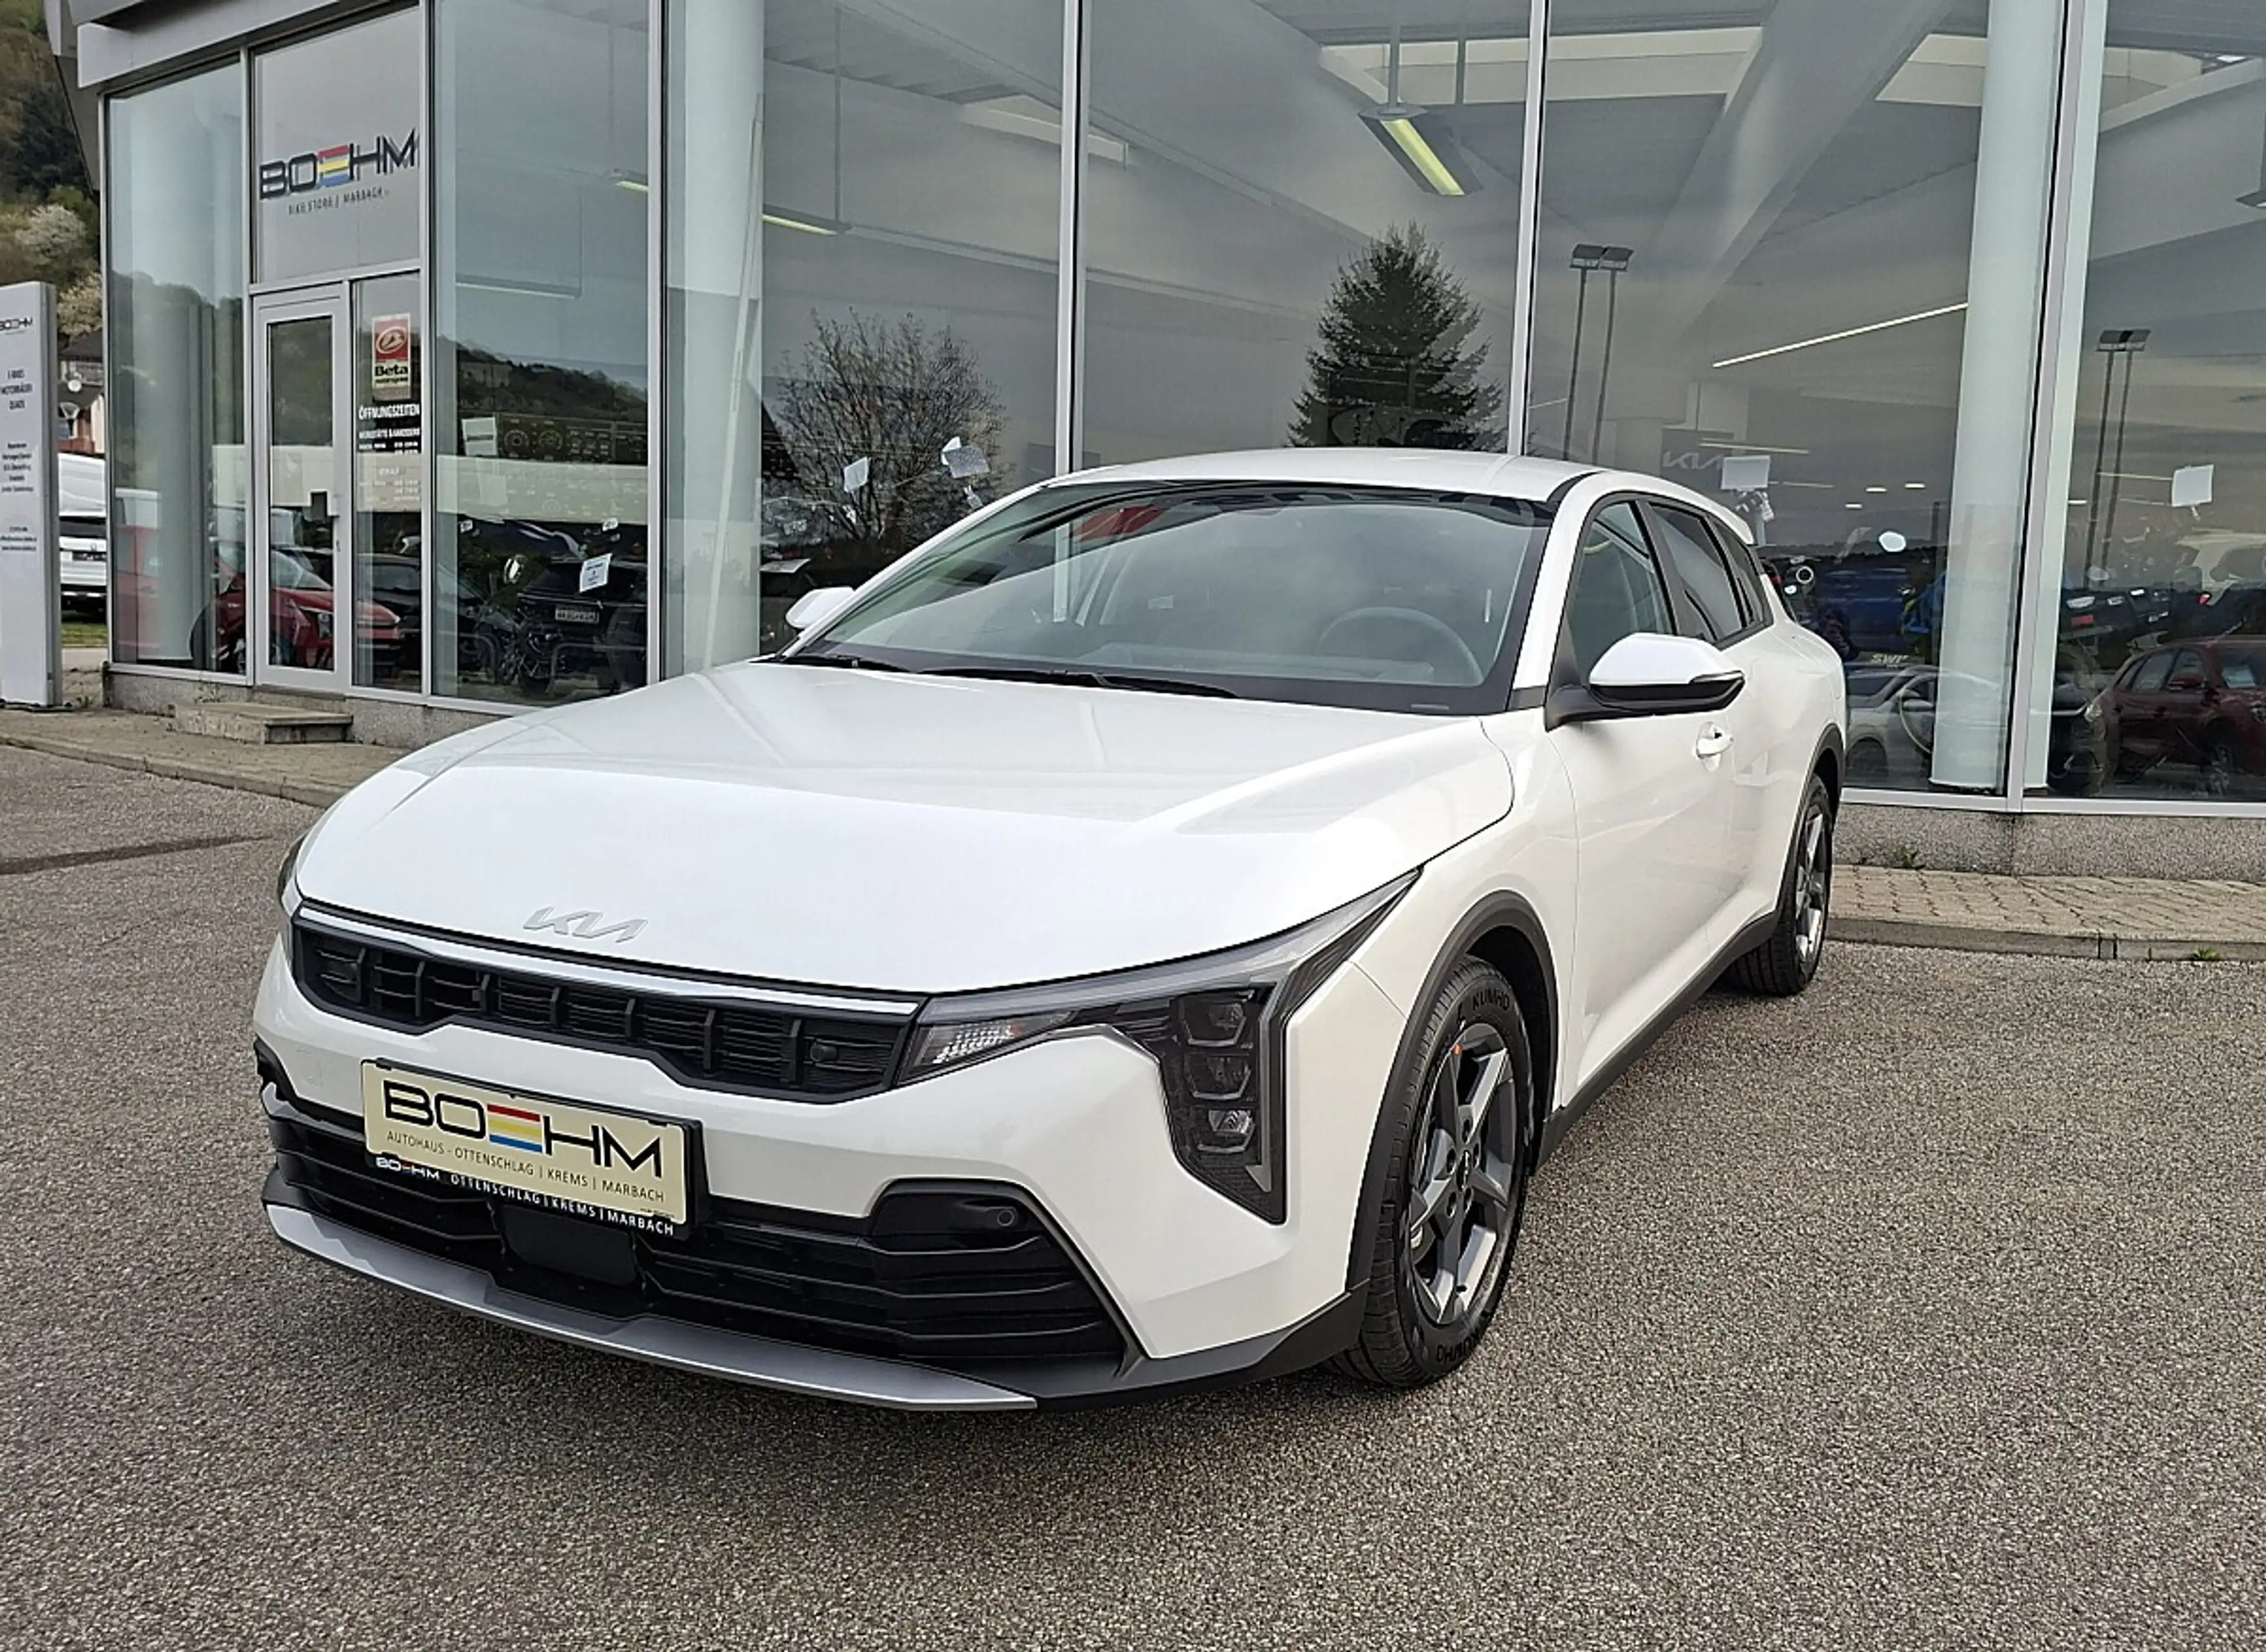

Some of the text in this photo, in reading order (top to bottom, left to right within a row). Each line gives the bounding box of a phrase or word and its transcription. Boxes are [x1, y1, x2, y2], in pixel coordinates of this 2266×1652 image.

[260, 128, 415, 199] BOEHM
[375, 364, 408, 376] Beta
[523, 906, 649, 943] KIA
[1473, 988, 1510, 1011] KUMHO
[384, 1079, 662, 1178] BOEHM
[387, 1130, 664, 1202] AUTOHAUS OTTENSCHLAG KREMS MARBACH
[451, 1174, 541, 1204] OTTENSCHLAG
[552, 1197, 596, 1217] KREMS
[608, 1210, 674, 1236] MARBACH
